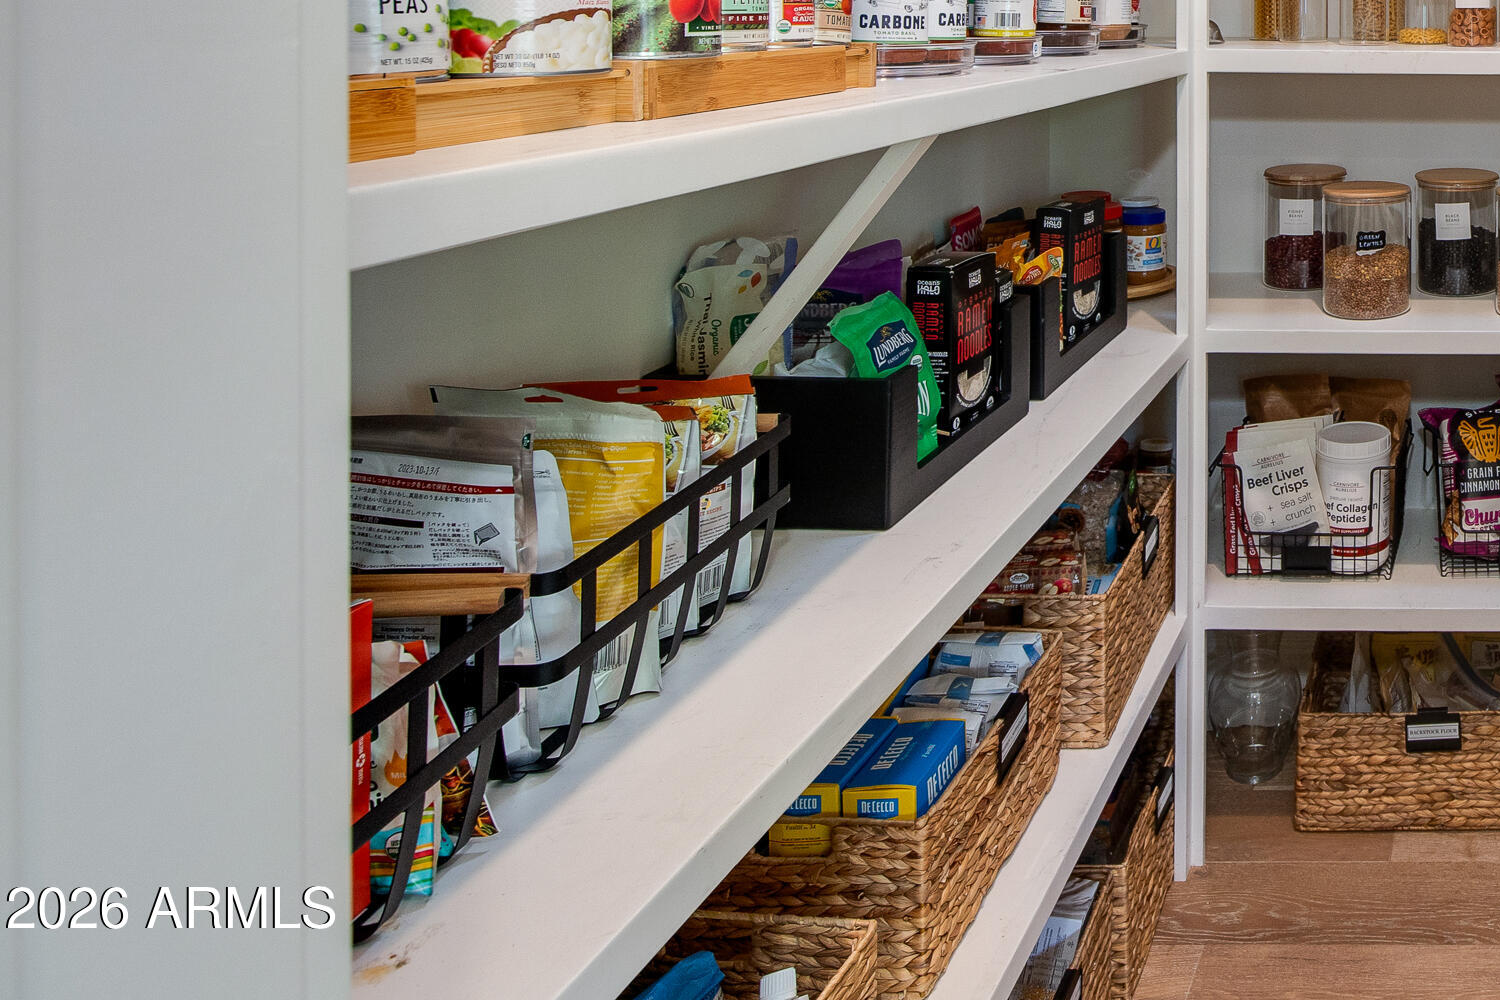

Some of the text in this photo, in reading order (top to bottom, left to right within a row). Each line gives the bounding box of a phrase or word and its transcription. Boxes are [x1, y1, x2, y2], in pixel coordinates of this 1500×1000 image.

[859, 13, 926, 29] CARBONE
[917, 285, 941, 296] HALO
[703, 293, 713, 324] Thai
[957, 297, 993, 336] RAMEN
[925, 302, 939, 341] RAMEN
[711, 319, 722, 356] Organic
[957, 325, 993, 365] NOODLES
[873, 328, 914, 367] LUNDBERG
[1256, 452, 1285, 464] CARNIVORE
[1260, 460, 1284, 470] AURELIUS
[1247, 465, 1305, 490] Beef Liver
[1467, 466, 1495, 479] GRAIN
[1271, 477, 1309, 496] Crisps
[1460, 481, 1500, 494] CINNAMON
[1280, 492, 1313, 510] sea salt
[1285, 503, 1317, 522] crunch
[1003, 584, 1018, 592] APPLE
[926, 744, 959, 806] DE CECCO
[795, 798, 818, 810] CECCO
[861, 801, 895, 813] DE CECCO
